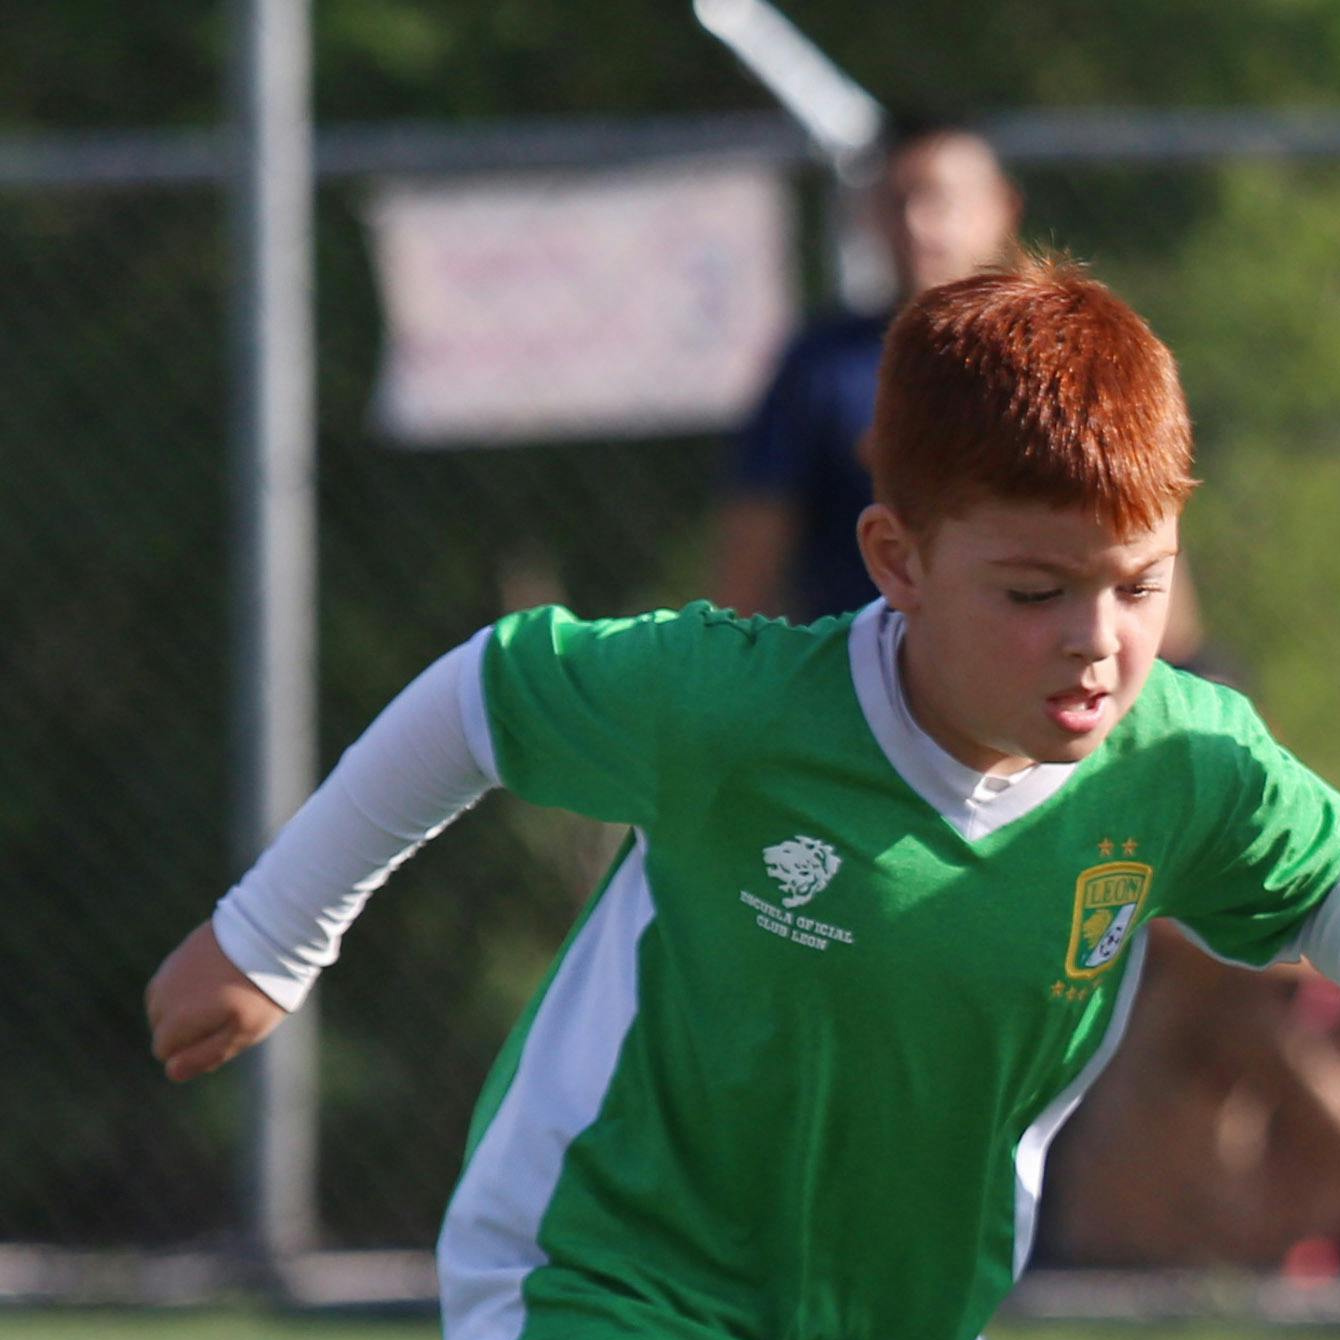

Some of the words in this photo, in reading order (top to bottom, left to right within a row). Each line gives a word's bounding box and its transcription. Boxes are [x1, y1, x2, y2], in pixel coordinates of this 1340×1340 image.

[756, 915, 789, 937] CLUB
[791, 930, 828, 950] LEON
[796, 916, 854, 944] OFICIAL
